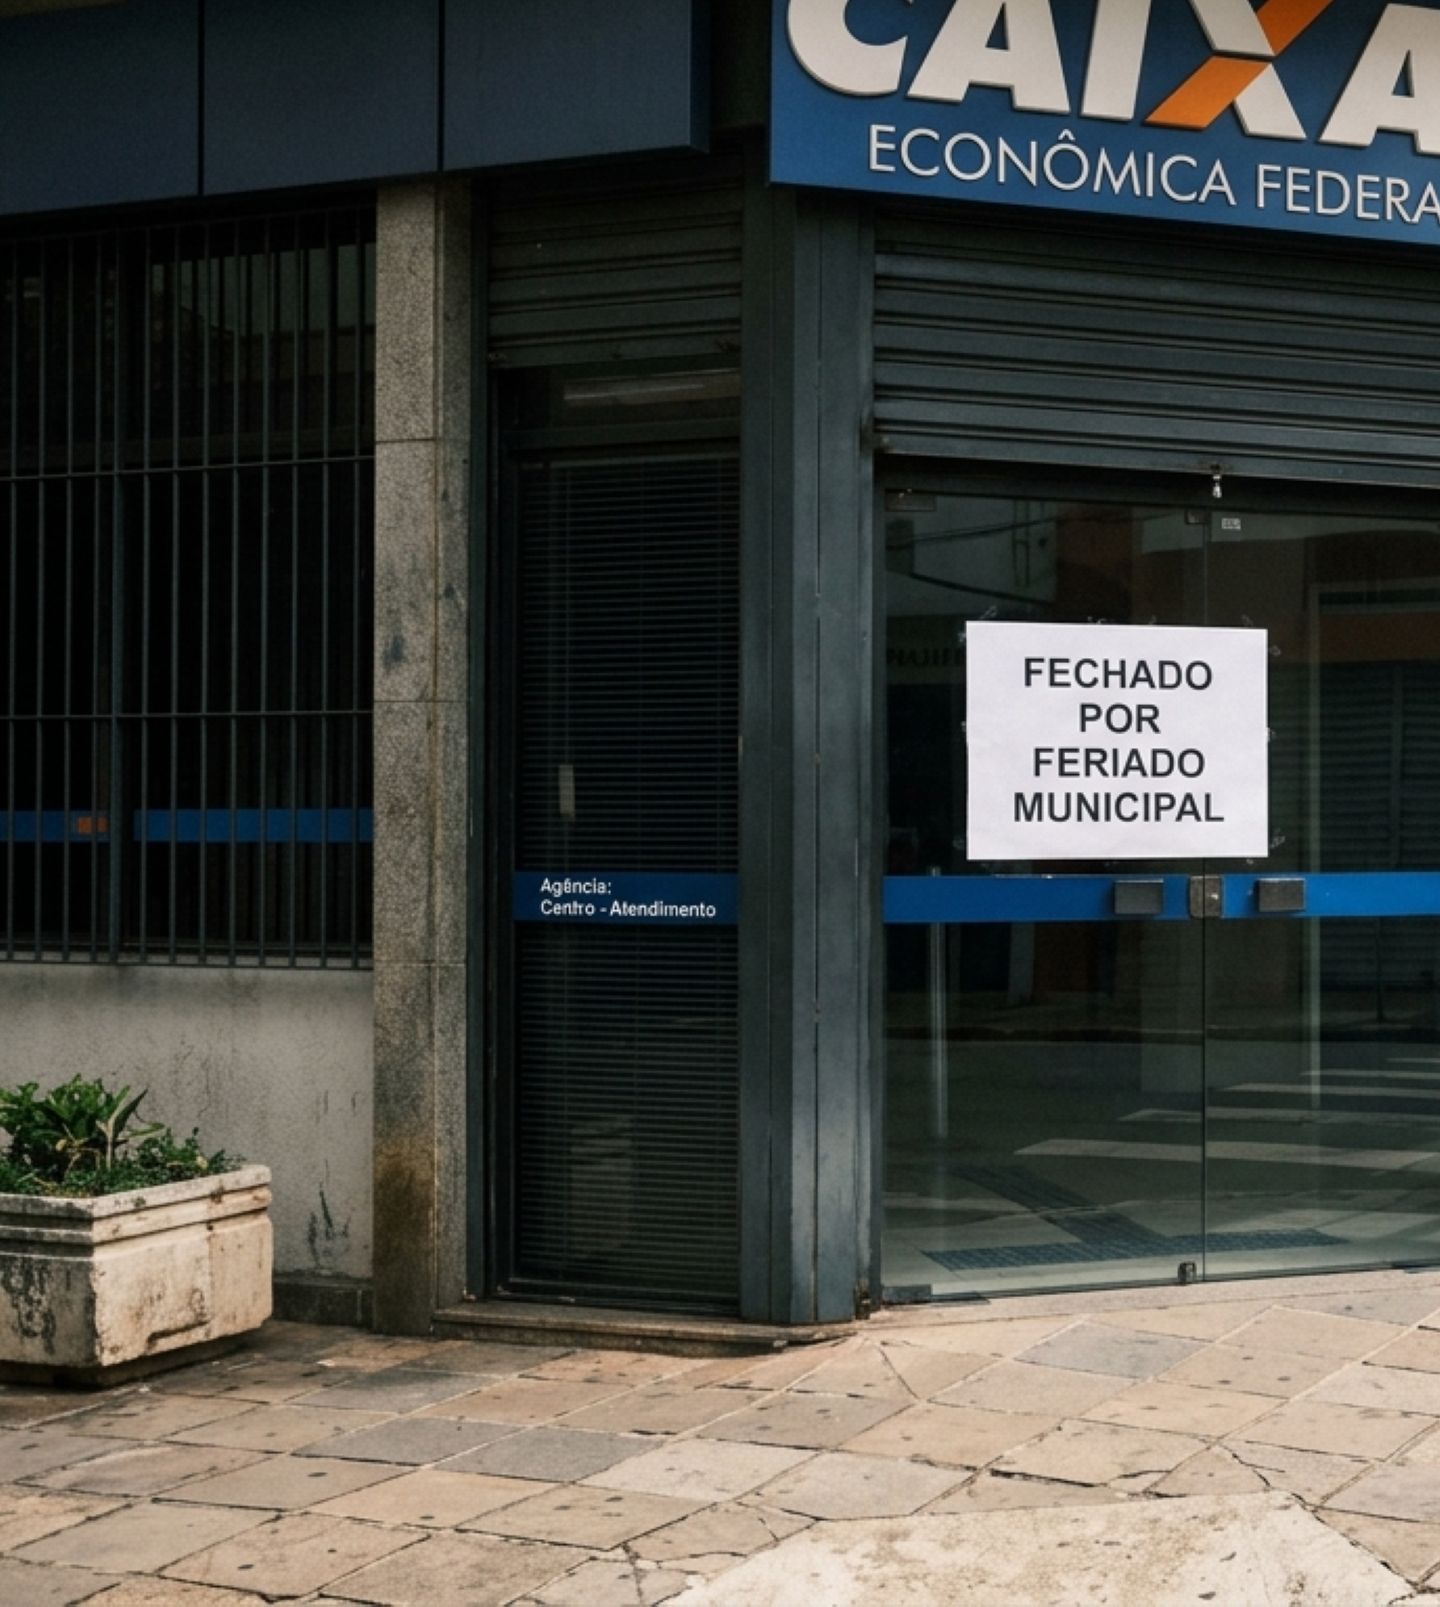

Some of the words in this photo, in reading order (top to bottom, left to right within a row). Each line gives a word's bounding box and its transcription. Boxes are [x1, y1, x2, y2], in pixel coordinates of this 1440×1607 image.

[868, 124, 1237, 206] ECONÔMICA
[1024, 657, 1212, 690] FECHADO
[1079, 703, 1161, 733] POR
[1034, 748, 1205, 778] FERIADO
[1013, 792, 1225, 822] MUNICIPAL
[540, 877, 612, 897] Agência:
[540, 899, 596, 916] Centro
[609, 900, 716, 918] Atendimento
